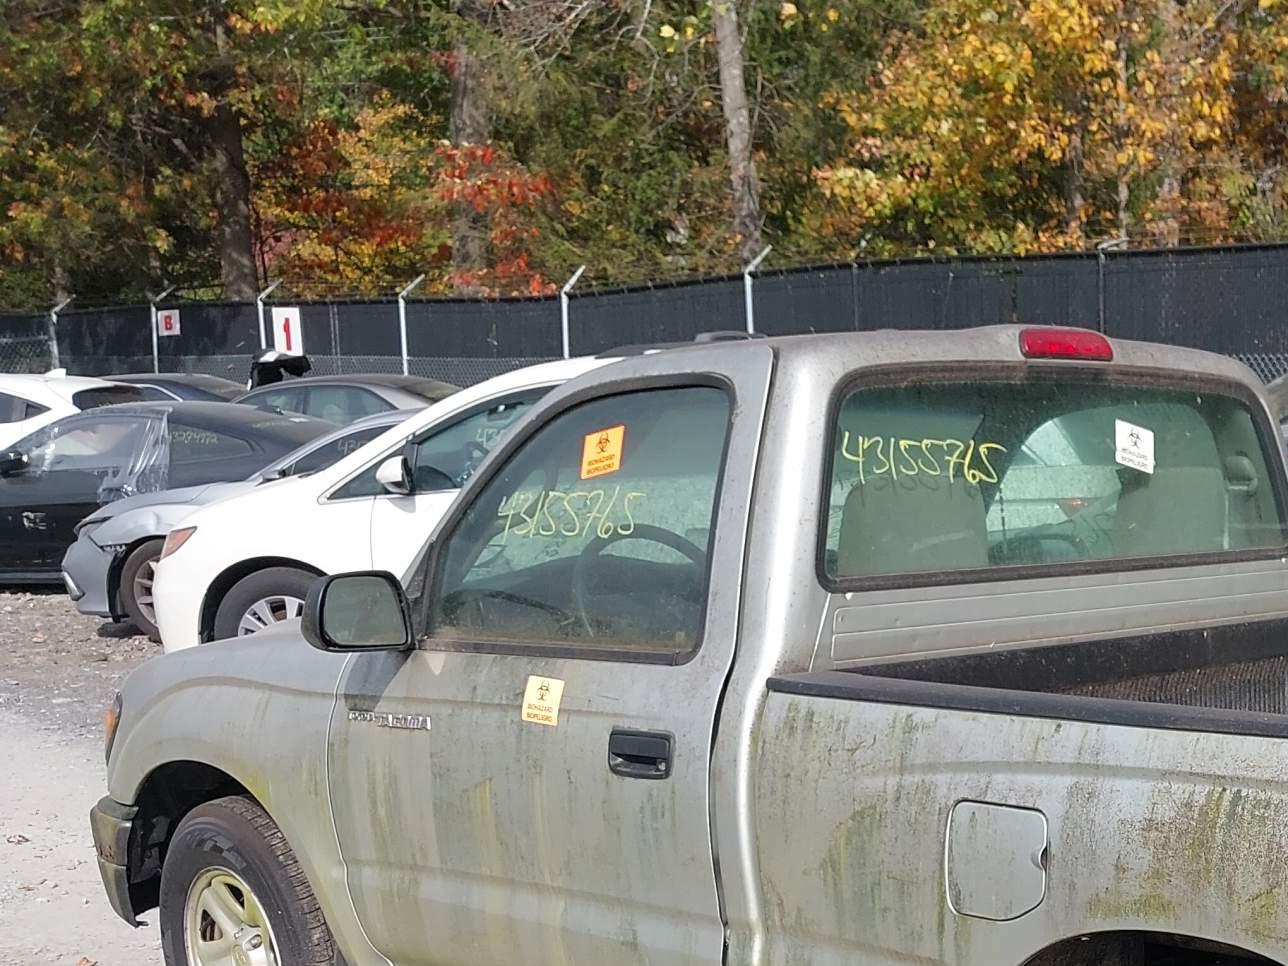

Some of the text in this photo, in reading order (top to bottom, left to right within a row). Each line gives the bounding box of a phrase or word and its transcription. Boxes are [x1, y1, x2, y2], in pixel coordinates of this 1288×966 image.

[284, 317, 292, 351] 1
[842, 431, 1007, 485] 43155765
[498, 485, 646, 544] 43155765
